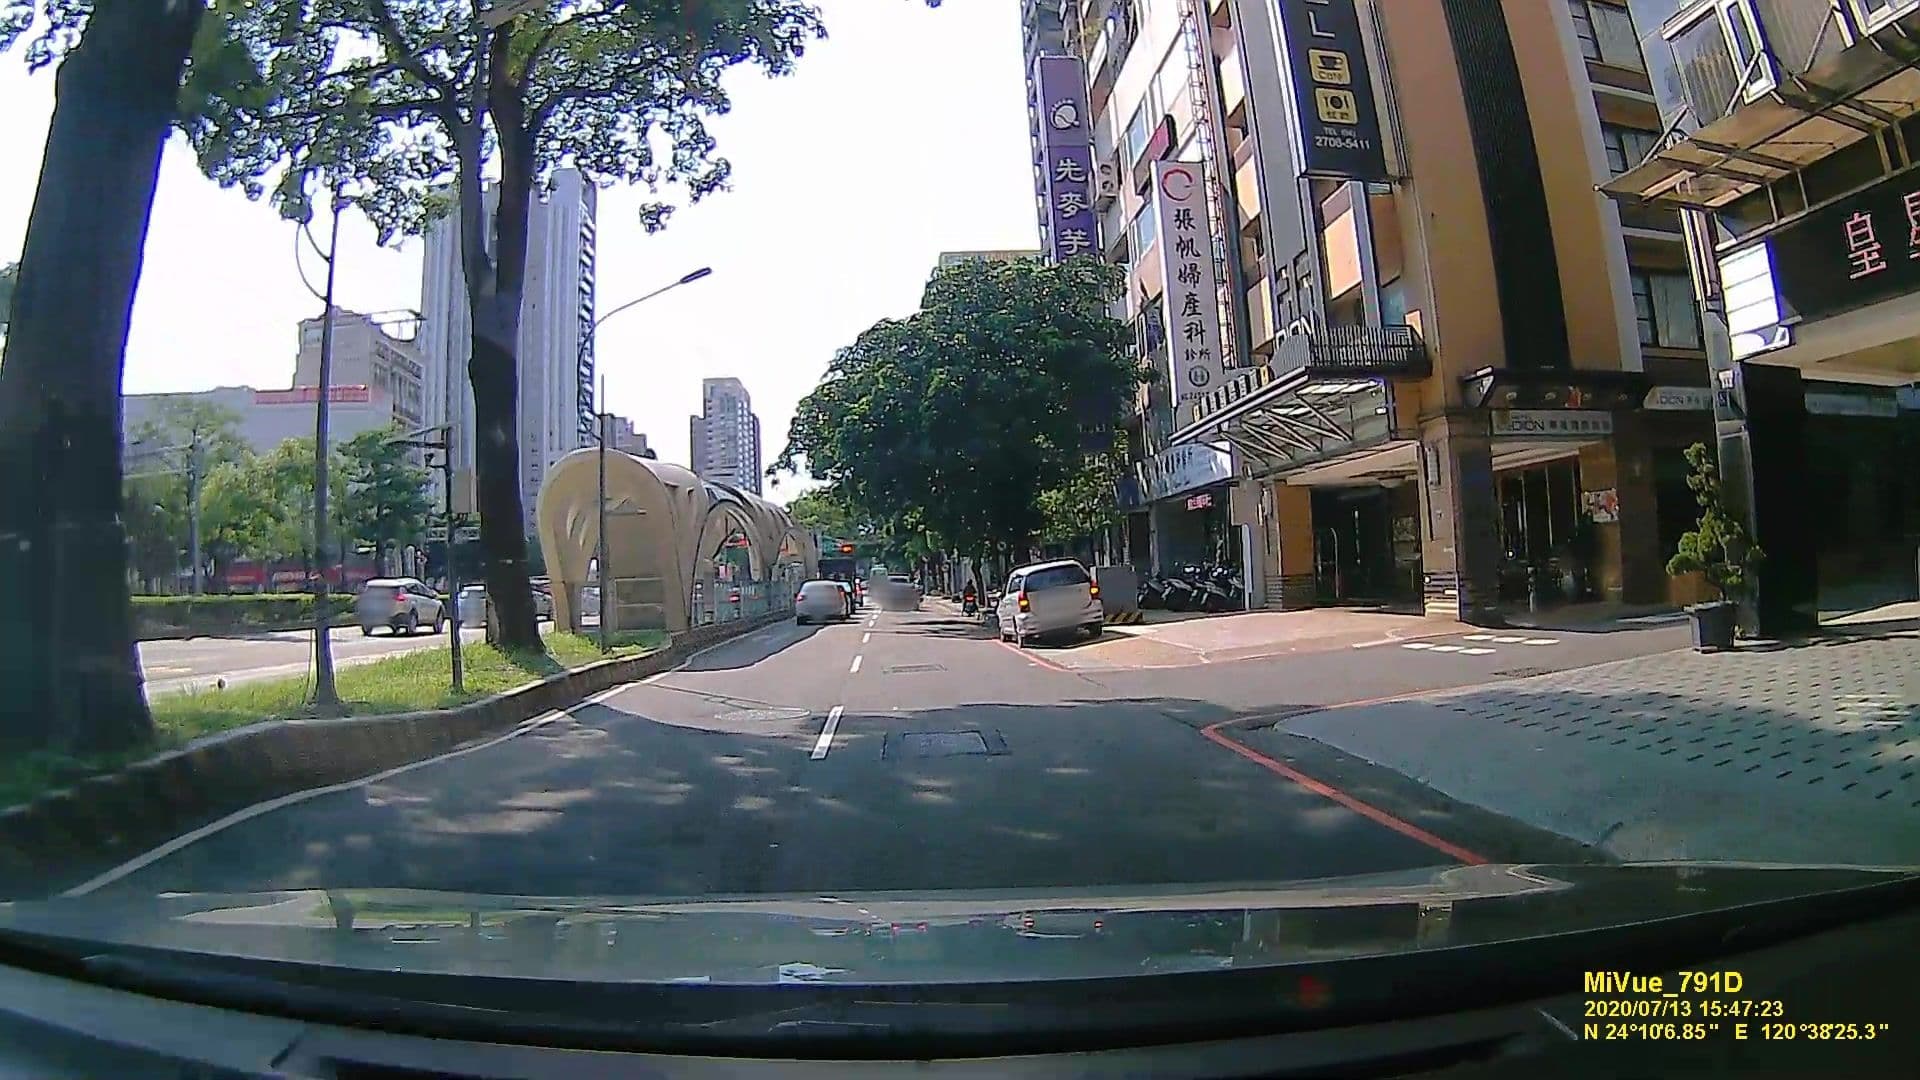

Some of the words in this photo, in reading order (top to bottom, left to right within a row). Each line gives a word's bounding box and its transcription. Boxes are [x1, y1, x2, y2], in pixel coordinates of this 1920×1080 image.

[1056, 158, 1091, 255] 先麥芋
[1174, 208, 1206, 345] 張帆婦產科
